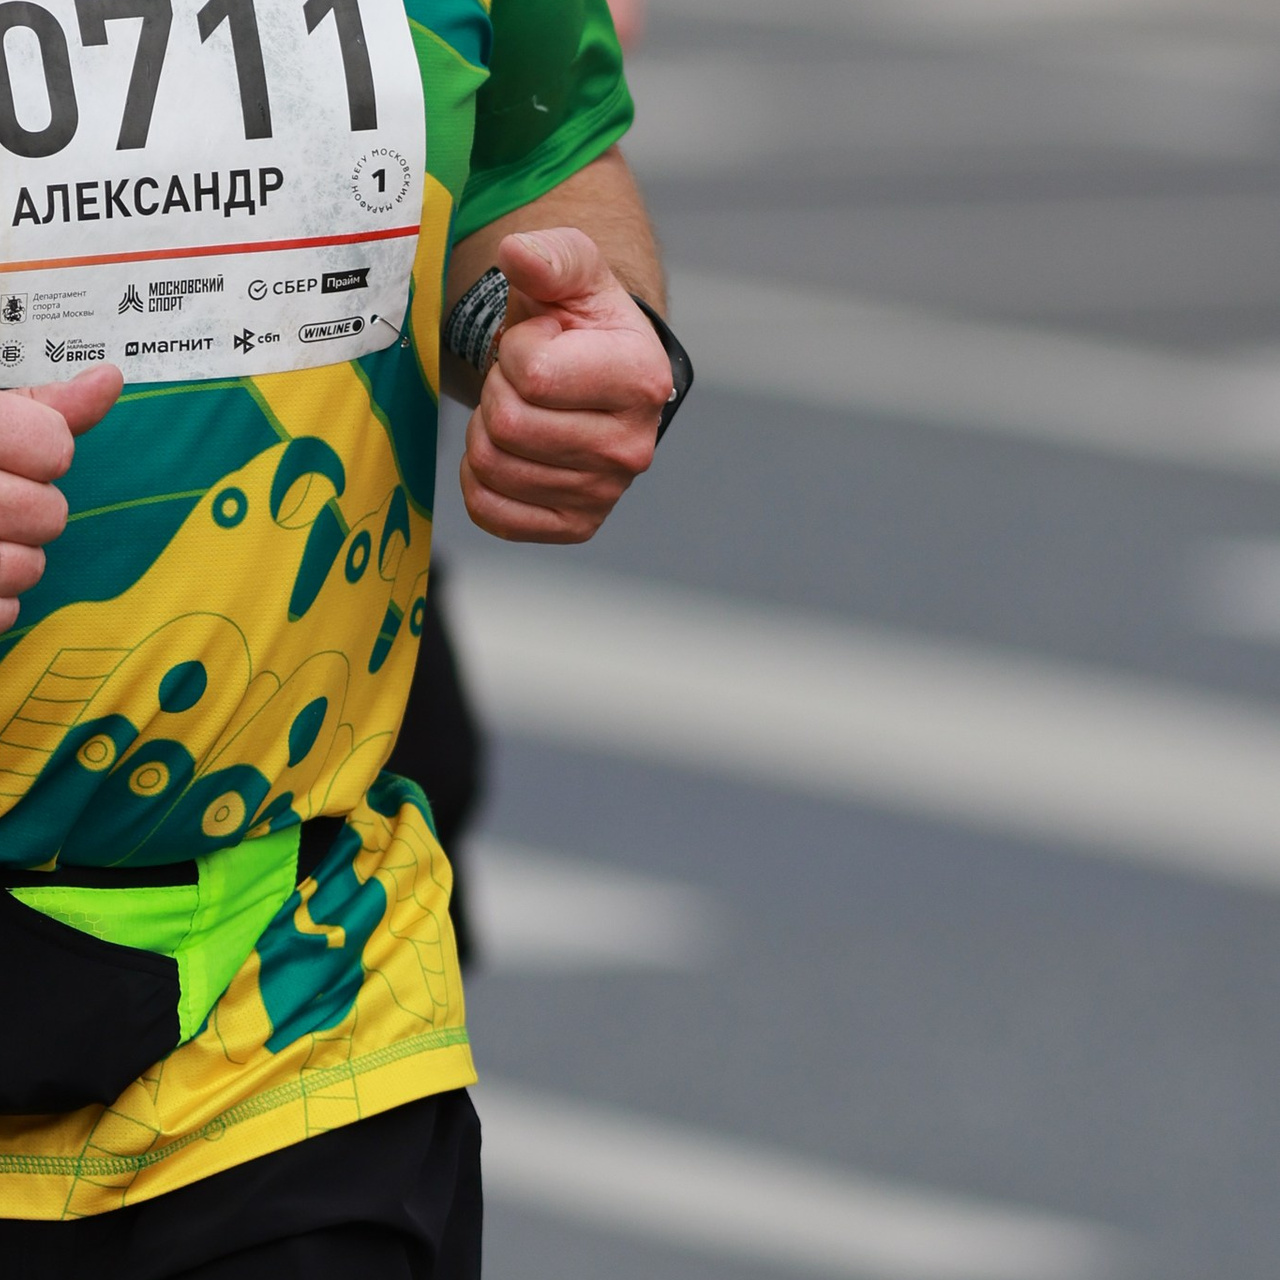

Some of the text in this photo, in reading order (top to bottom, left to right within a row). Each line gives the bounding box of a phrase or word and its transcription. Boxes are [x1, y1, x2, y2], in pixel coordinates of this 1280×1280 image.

[371, 168, 386, 193] 1
[12, 167, 284, 227] АЛЕКСАНДР
[148, 274, 224, 297] МОСКОВСКИЙ
[273, 274, 361, 295] СБЕР Прайм
[32, 290, 87, 302] Департамент
[148, 296, 184, 313] СПОРТ
[32, 302, 61, 312] спорта
[32, 310, 95, 321] города Москвы
[257, 332, 280, 344] сбп
[304, 322, 351, 339] WINLINE
[66, 349, 106, 362] BRICS
